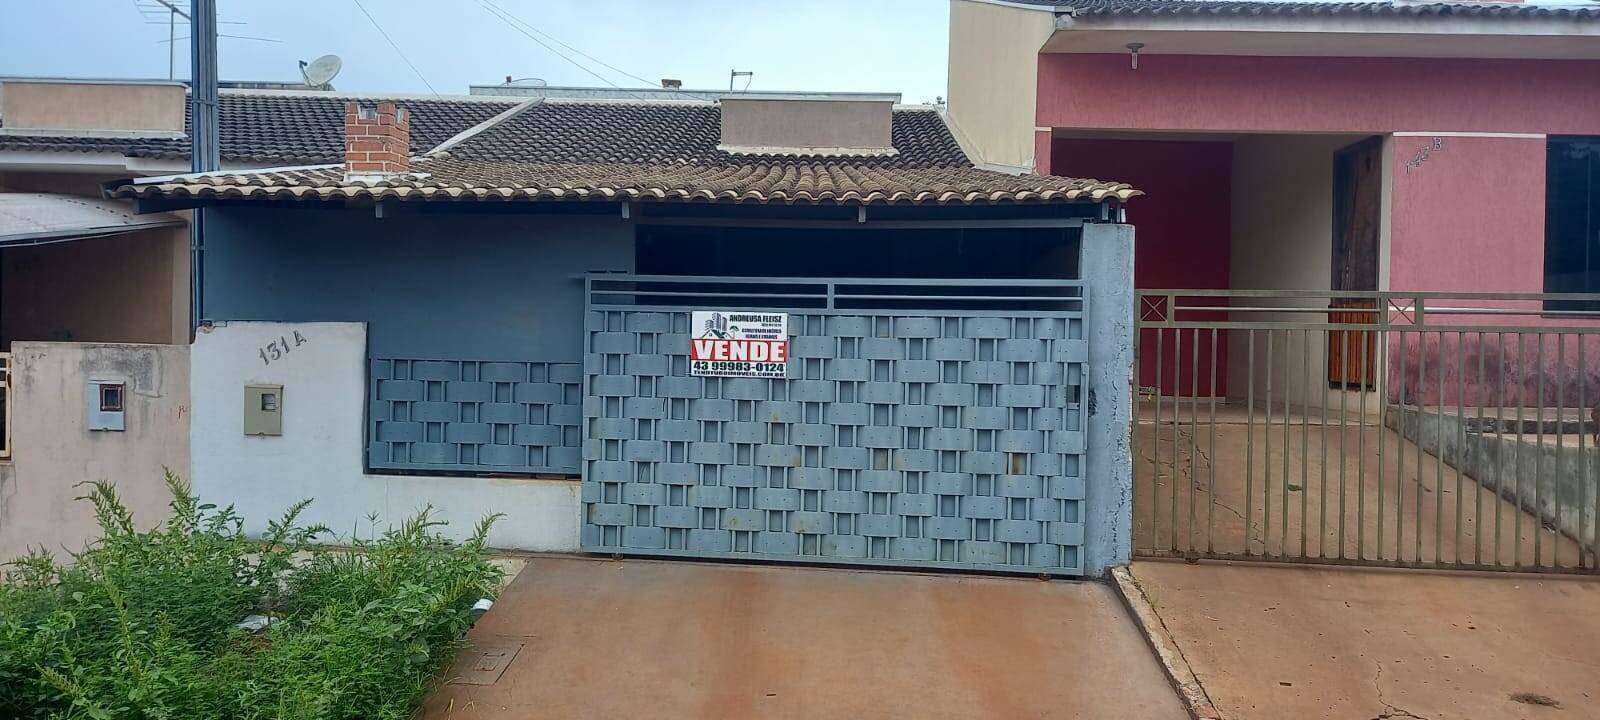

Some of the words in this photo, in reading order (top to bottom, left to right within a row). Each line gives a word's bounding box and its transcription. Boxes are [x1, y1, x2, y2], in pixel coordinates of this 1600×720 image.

[1432, 138, 1442, 151] B
[259, 336, 290, 366] 131
[293, 329, 307, 347] A
[693, 340, 785, 362] VENDE
[693, 361, 709, 371] 43
[711, 362, 784, 372] 99983-0124
